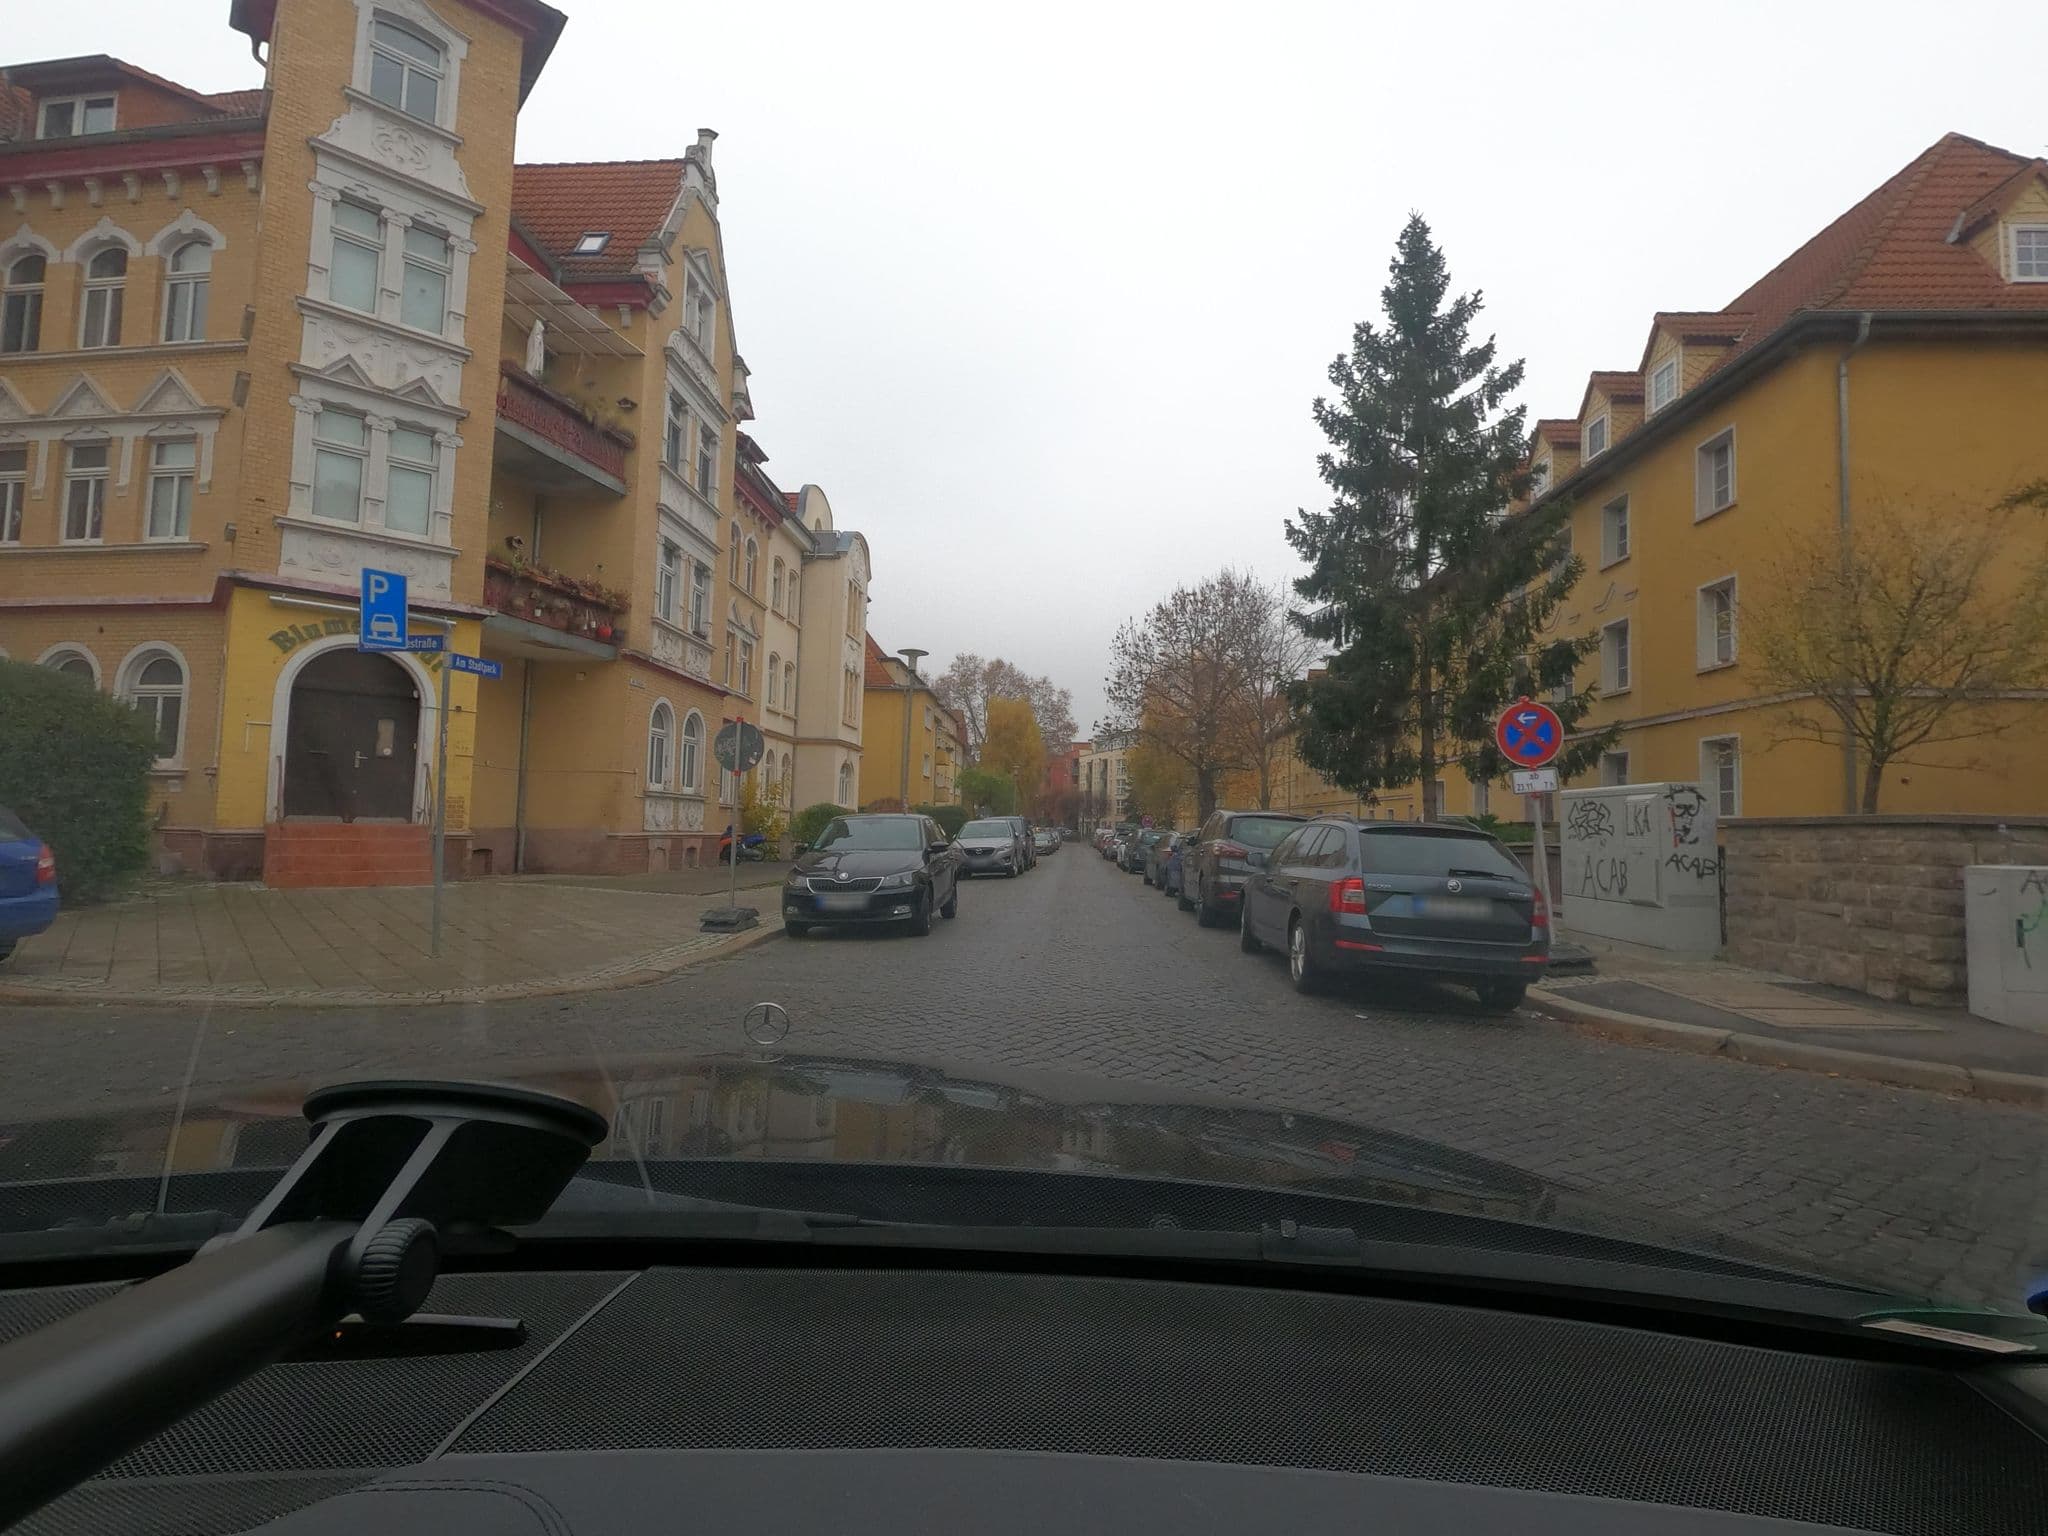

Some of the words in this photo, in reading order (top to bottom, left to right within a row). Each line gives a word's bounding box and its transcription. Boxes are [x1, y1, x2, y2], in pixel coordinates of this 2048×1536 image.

[369, 574, 389, 603] P
[455, 656, 466, 668] Am
[468, 659, 497, 675] Stadtpark
[1581, 855, 1628, 899] ACAB
[1665, 853, 1718, 879] ACAB
